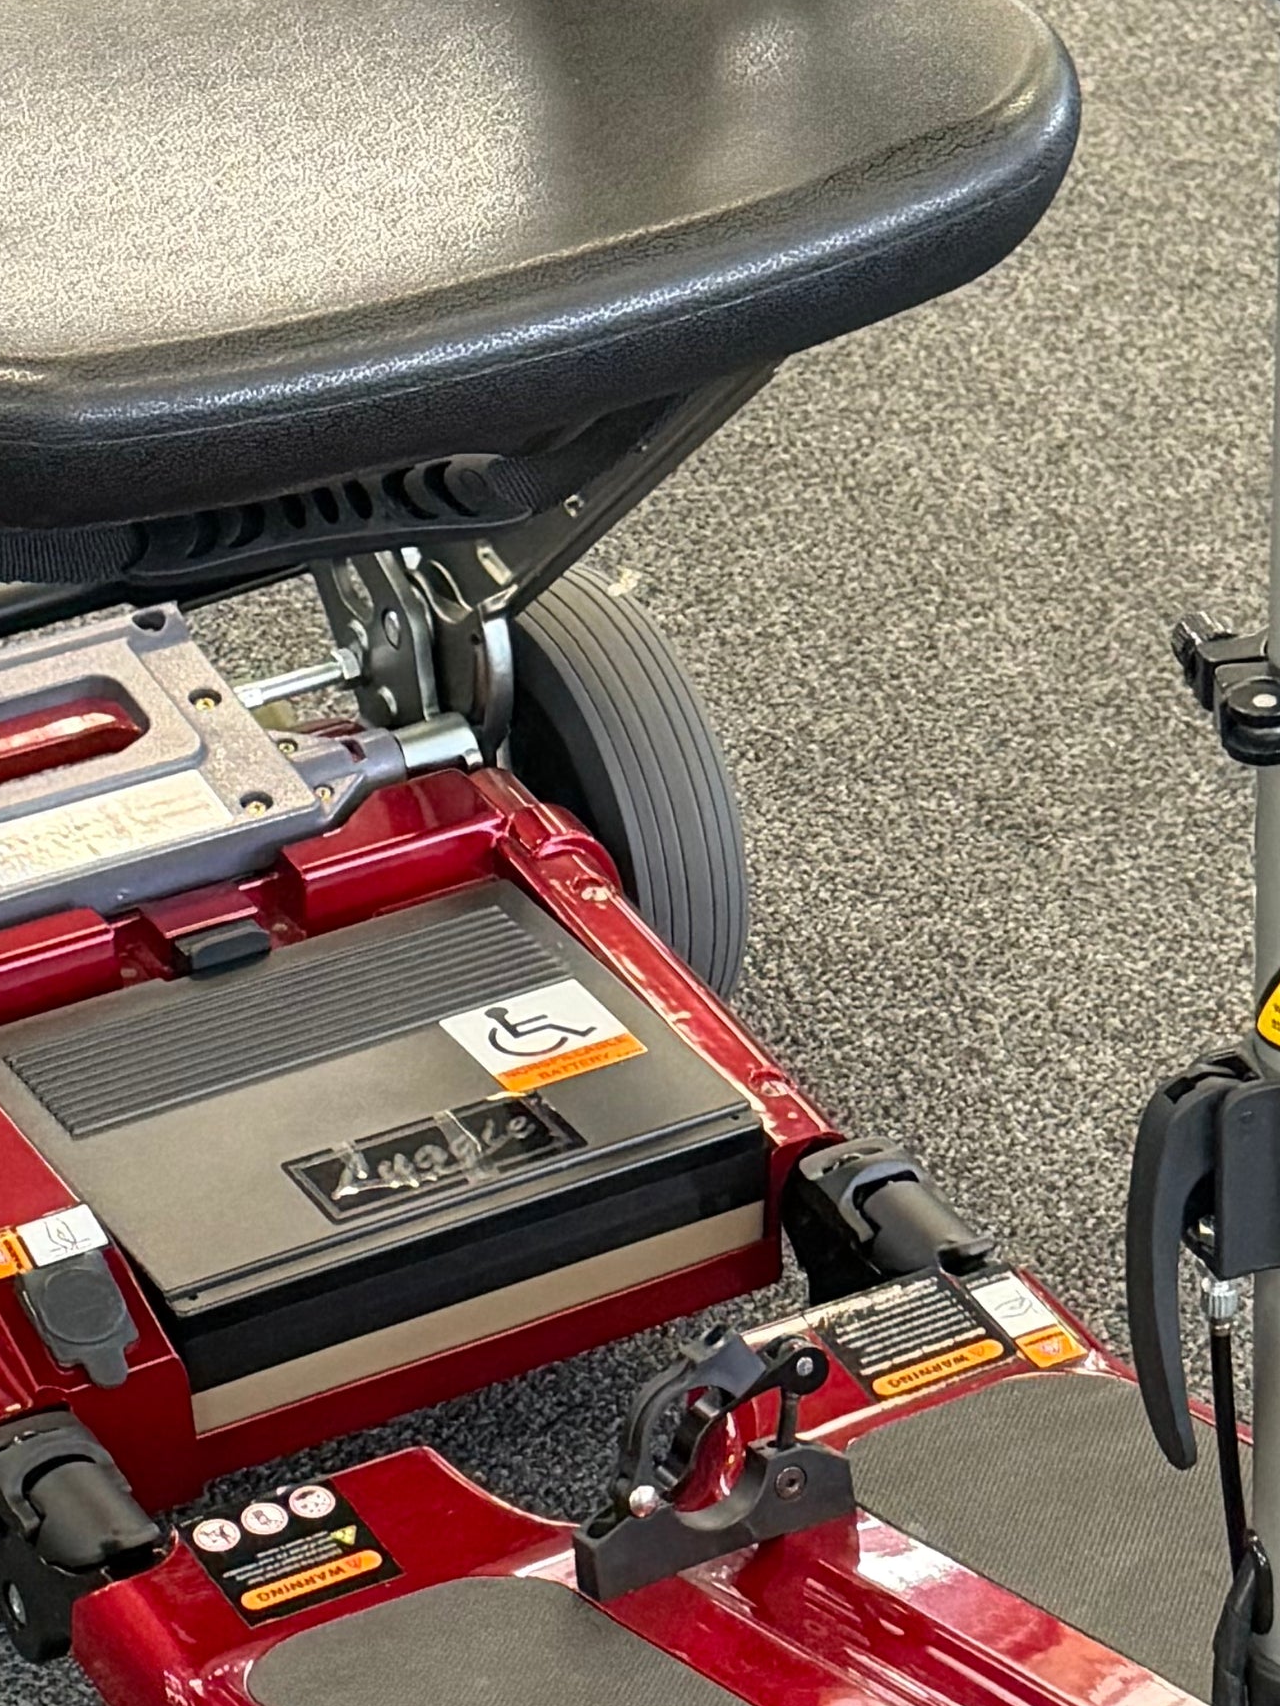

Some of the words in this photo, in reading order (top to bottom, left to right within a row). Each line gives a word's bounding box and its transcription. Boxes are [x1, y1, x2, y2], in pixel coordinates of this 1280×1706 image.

[537, 1052, 610, 1080] BATTERY
[888, 1353, 970, 1389] WARNING
[256, 1565, 346, 1602] WARNING
